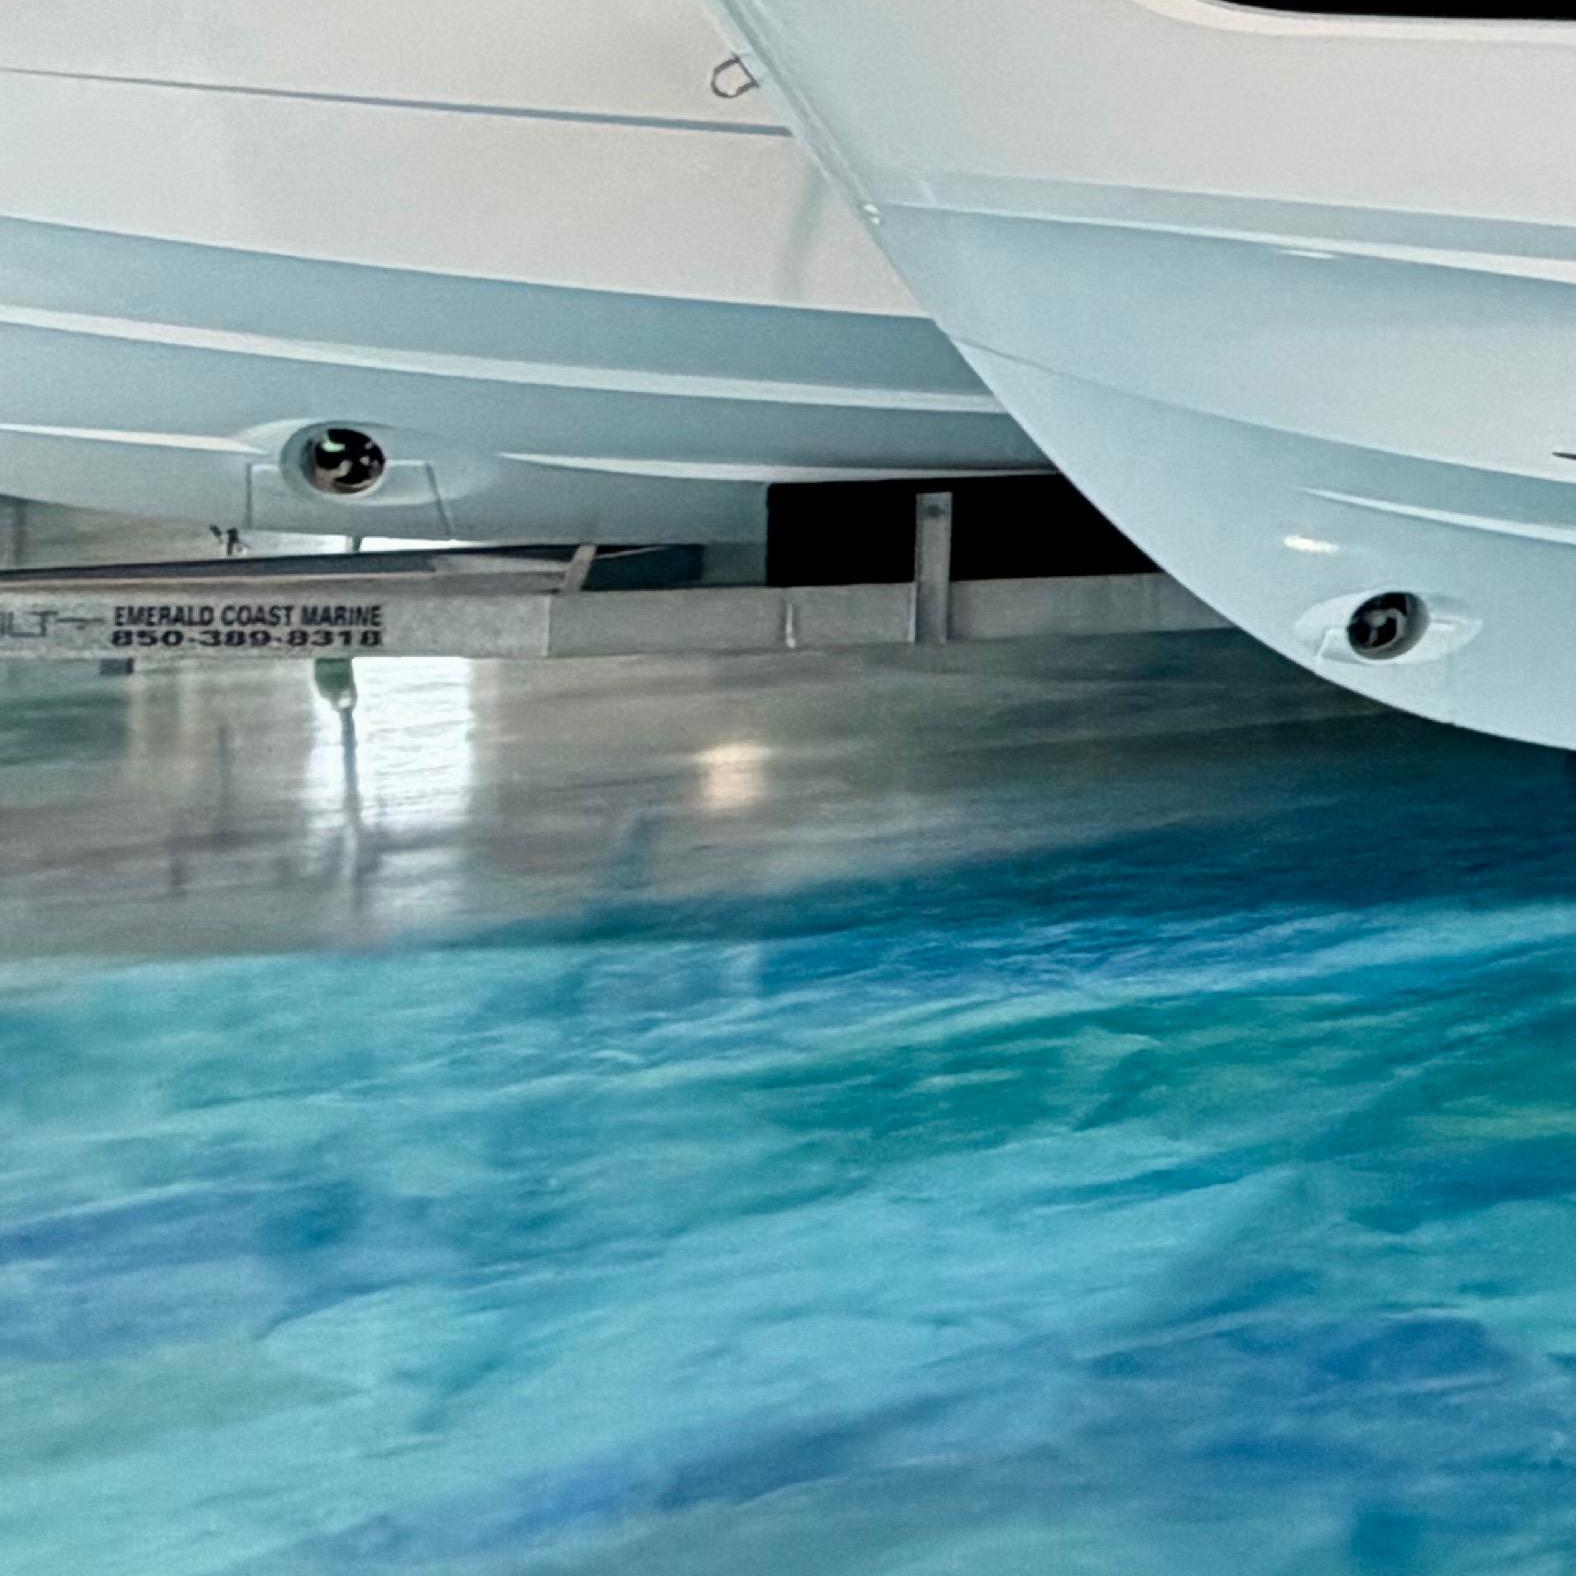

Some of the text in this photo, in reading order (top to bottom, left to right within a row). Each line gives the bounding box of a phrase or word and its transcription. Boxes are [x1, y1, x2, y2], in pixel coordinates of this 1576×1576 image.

[114, 604, 384, 627] EMERALD COAST MARINE
